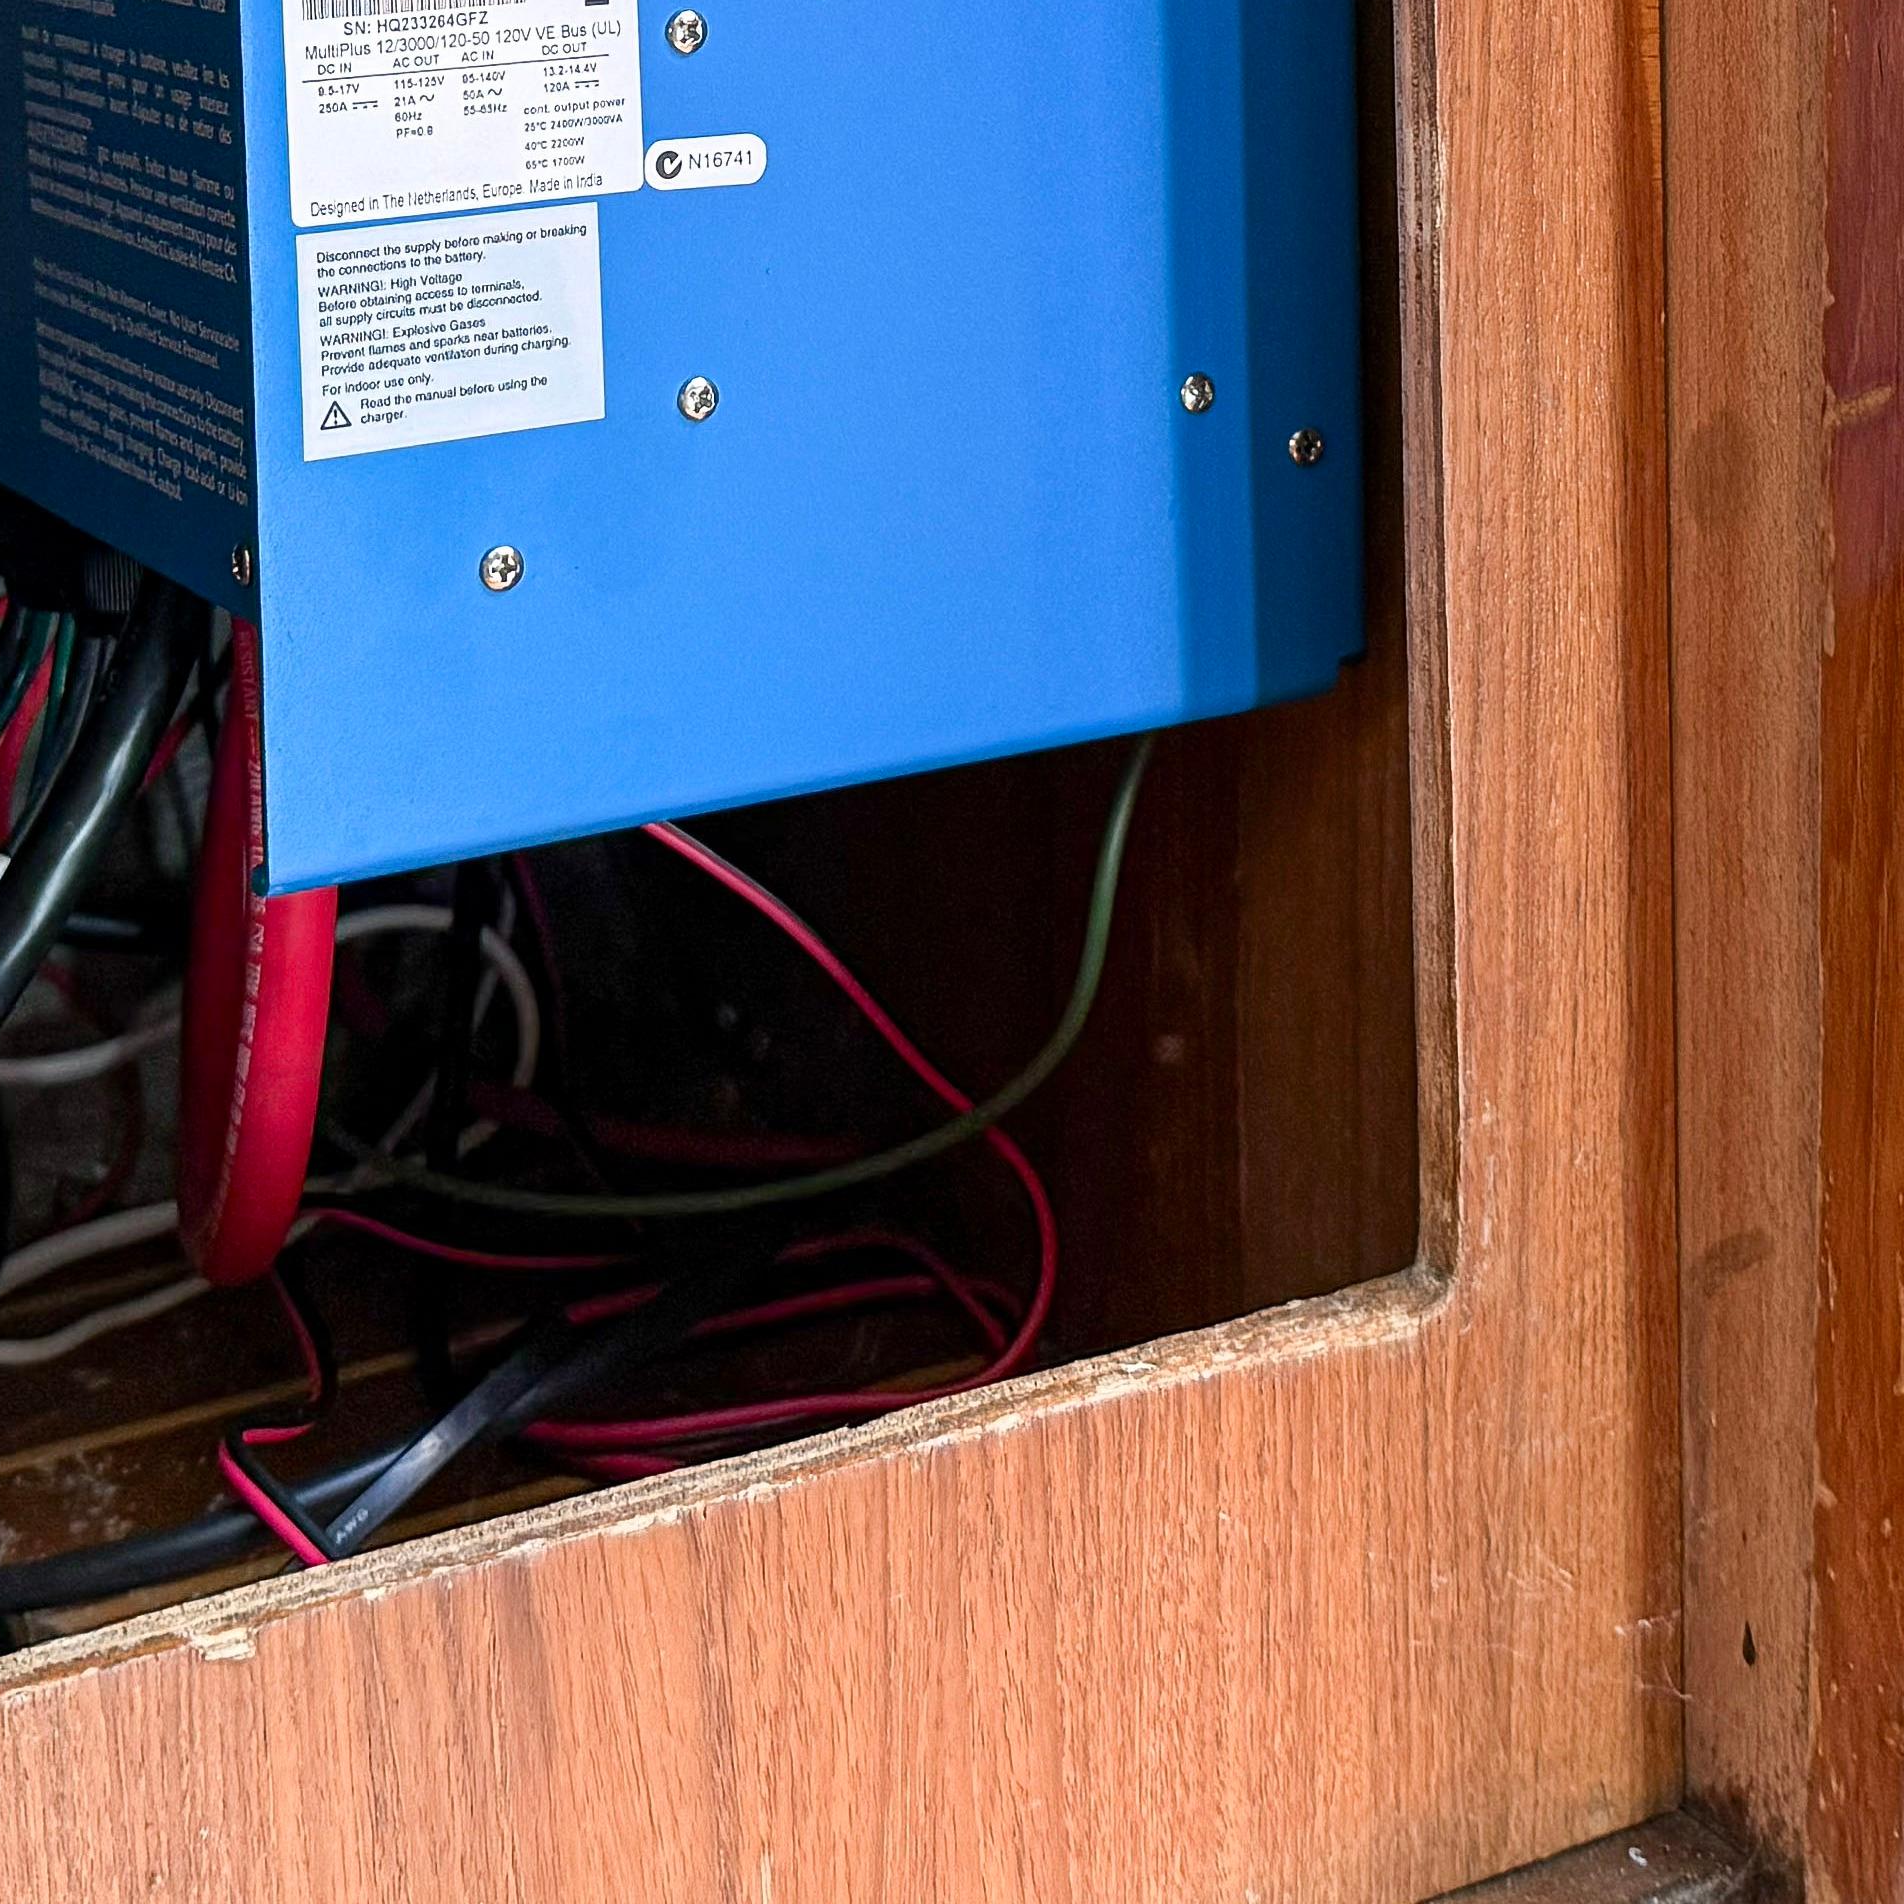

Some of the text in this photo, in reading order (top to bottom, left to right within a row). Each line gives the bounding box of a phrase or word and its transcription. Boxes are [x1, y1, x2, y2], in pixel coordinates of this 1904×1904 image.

[343, 11, 489, 36] SN: HQ233264GFZ
[305, 19, 622, 60] MultiPlus 12/3000/120-50 120V VE Bus (UL)
[542, 41, 587, 55] DC OUT
[393, 54, 440, 68] AC OUT
[461, 50, 494, 62] AC IN
[317, 62, 352, 75] DC IN
[544, 81, 570, 93] 120A
[394, 95, 417, 107] 21A
[554, 100, 590, 113] output
[593, 98, 625, 110] power
[689, 150, 752, 170] N16741
[310, 197, 365, 218] Designed
[369, 196, 379, 211] in
[382, 193, 404, 209] The
[529, 179, 560, 194] Made
[563, 177, 574, 190] in
[576, 173, 603, 189] India
[317, 224, 587, 264] Disconnect the supply before making or breaking
[317, 250, 486, 279] the connections to the battery.
[390, 277, 417, 292] High
[420, 272, 463, 287] Voltage
[318, 298, 357, 313] Before
[360, 292, 412, 308] obtaining
[415, 288, 454, 301] access
[456, 284, 468, 295] to
[319, 315, 333, 328] all
[335, 309, 373, 327] supply
[376, 304, 416, 321] circuits
[419, 302, 447, 315] must
[449, 298, 463, 313] be
[392, 324, 446, 340] Explosive
[449, 317, 486, 331] Gases
[321, 346, 366, 362] Prevent
[368, 341, 406, 356] flames
[409, 337, 431, 351] and
[433, 333, 471, 349] sparks
[473, 329, 499, 343] near
[321, 360, 365, 377] Provide
[368, 356, 421, 371] adequate
[483, 342, 519, 356] during
[322, 384, 342, 397] For
[344, 378, 381, 395] indoor
[384, 375, 405, 389] use
[360, 374, 548, 409] Read the manual before using the
